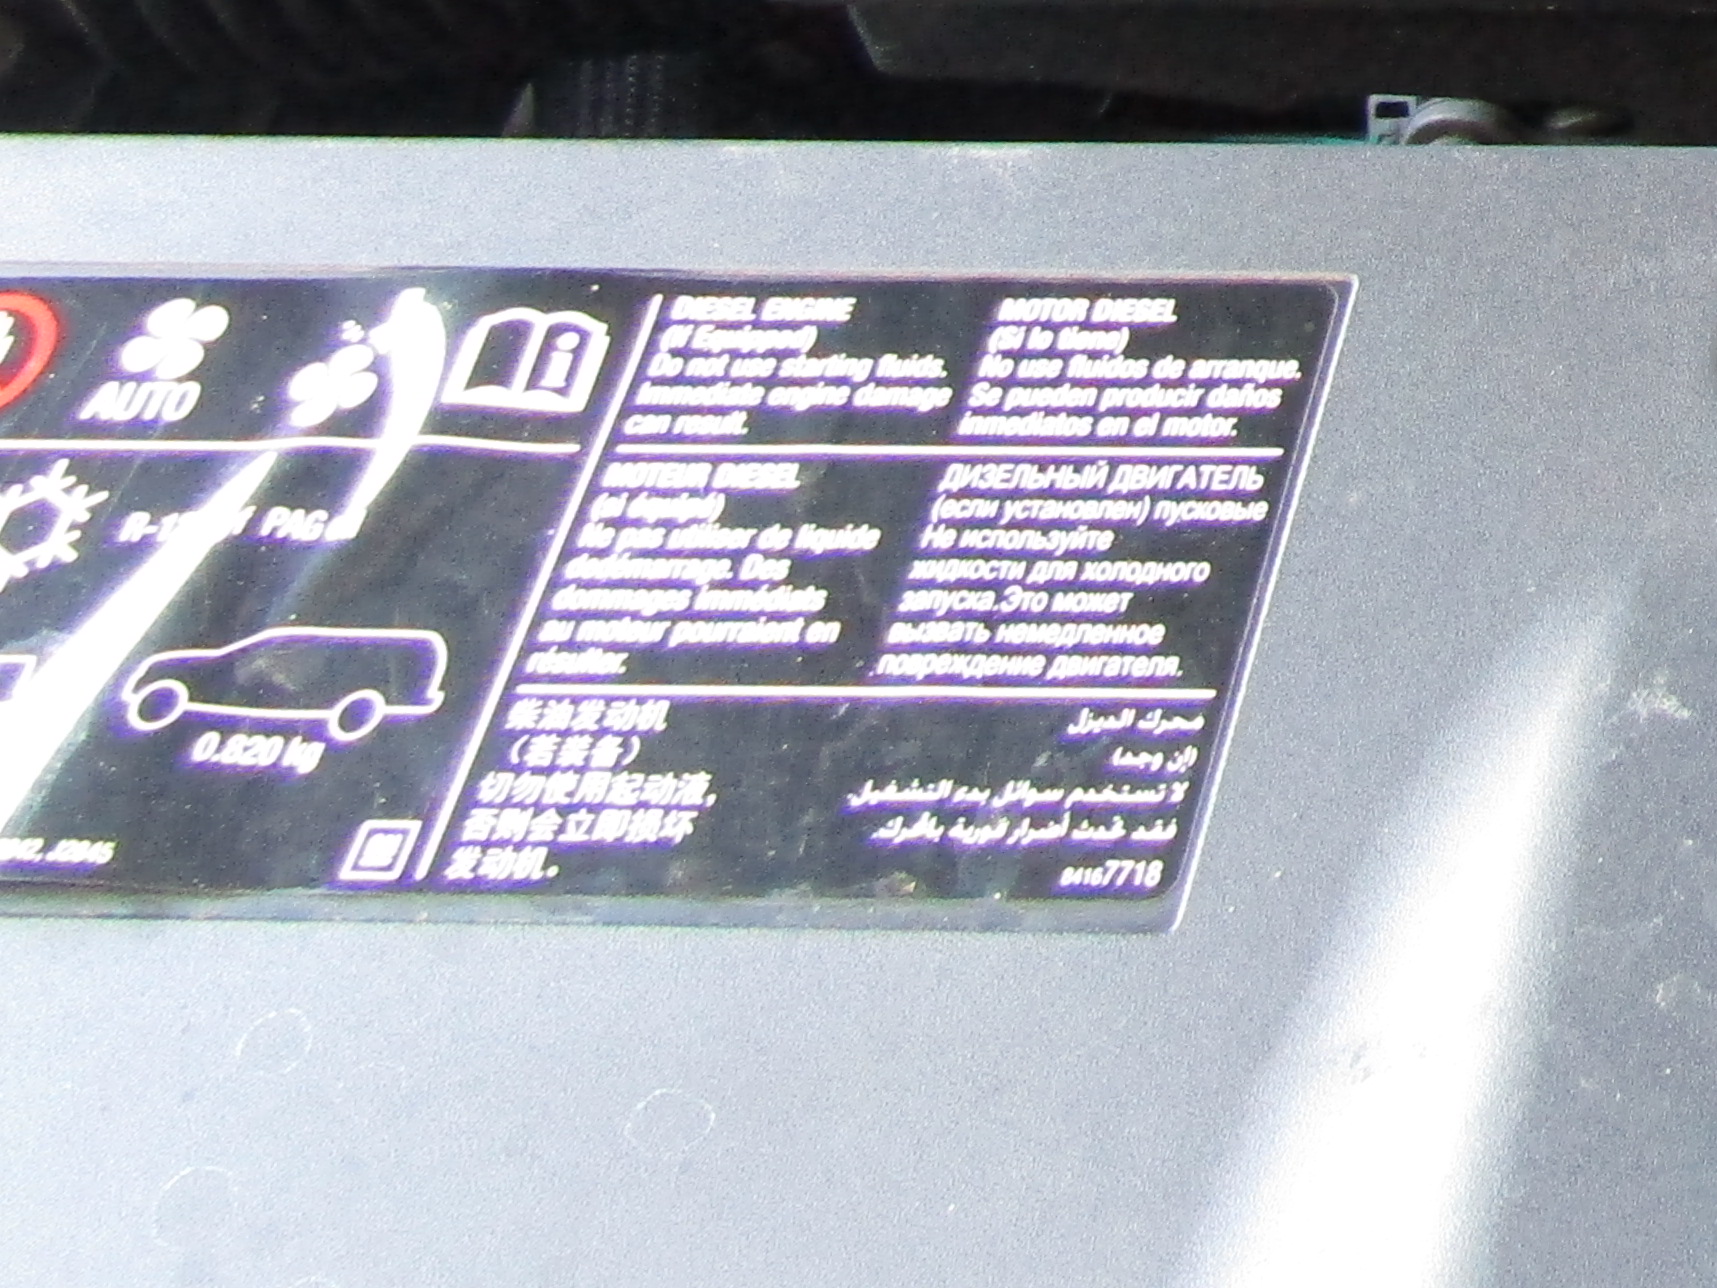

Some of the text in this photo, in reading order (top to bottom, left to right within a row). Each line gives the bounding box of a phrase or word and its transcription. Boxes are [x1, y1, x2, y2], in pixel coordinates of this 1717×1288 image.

[670, 295, 857, 322] DIESEL ENGINE
[997, 298, 1178, 323] MOTOR DIESEL
[690, 324, 818, 353] Equipped)
[987, 325, 1130, 354] (Si lo tiene)
[647, 352, 948, 382] Do not use starting fluids.
[978, 354, 1302, 383] No use fluidos de arranque.
[79, 380, 202, 422] AUTO
[635, 381, 953, 412] Immediate engine damage
[968, 381, 1283, 412] Se pueden producir daños
[624, 410, 749, 435] can result.
[956, 411, 1238, 438] inmediatos en el motor.
[602, 462, 801, 489] MOTEUR DIESEL
[938, 460, 1265, 494] ДИЗЕЛЬНЫЙ ДВИГАТЕЛЬ
[931, 495, 1269, 526] (если установлен) пусковые
[576, 522, 882, 555] Ne pas utiliser de liquide
[920, 524, 1116, 556] Не используйте
[738, 553, 792, 581] Des
[908, 558, 1211, 585] жидкости для холодного
[551, 583, 829, 616] dommages immédiats
[1051, 591, 1135, 614] может
[537, 616, 842, 648] au moteur pourraient en
[887, 621, 1167, 647] вызвать немедленное
[525, 645, 631, 674] résulter.
[876, 652, 1184, 680] повреждение двигателя.
[504, 698, 671, 731] 柴油发动机
[1067, 707, 1205, 734] محرك الديزل
[191, 730, 326, 774] 0.820 kg
[953, 782, 991, 806] بدء
[992, 779, 1065, 807] سوائل
[1064, 782, 1165, 808] تستخدم
[1168, 781, 1190, 802] لا
[461, 807, 698, 844] 否则会立即损坏
[949, 817, 1010, 844] فورية
[1006, 811, 1071, 845] أضرار
[1129, 817, 1178, 841] فقد
